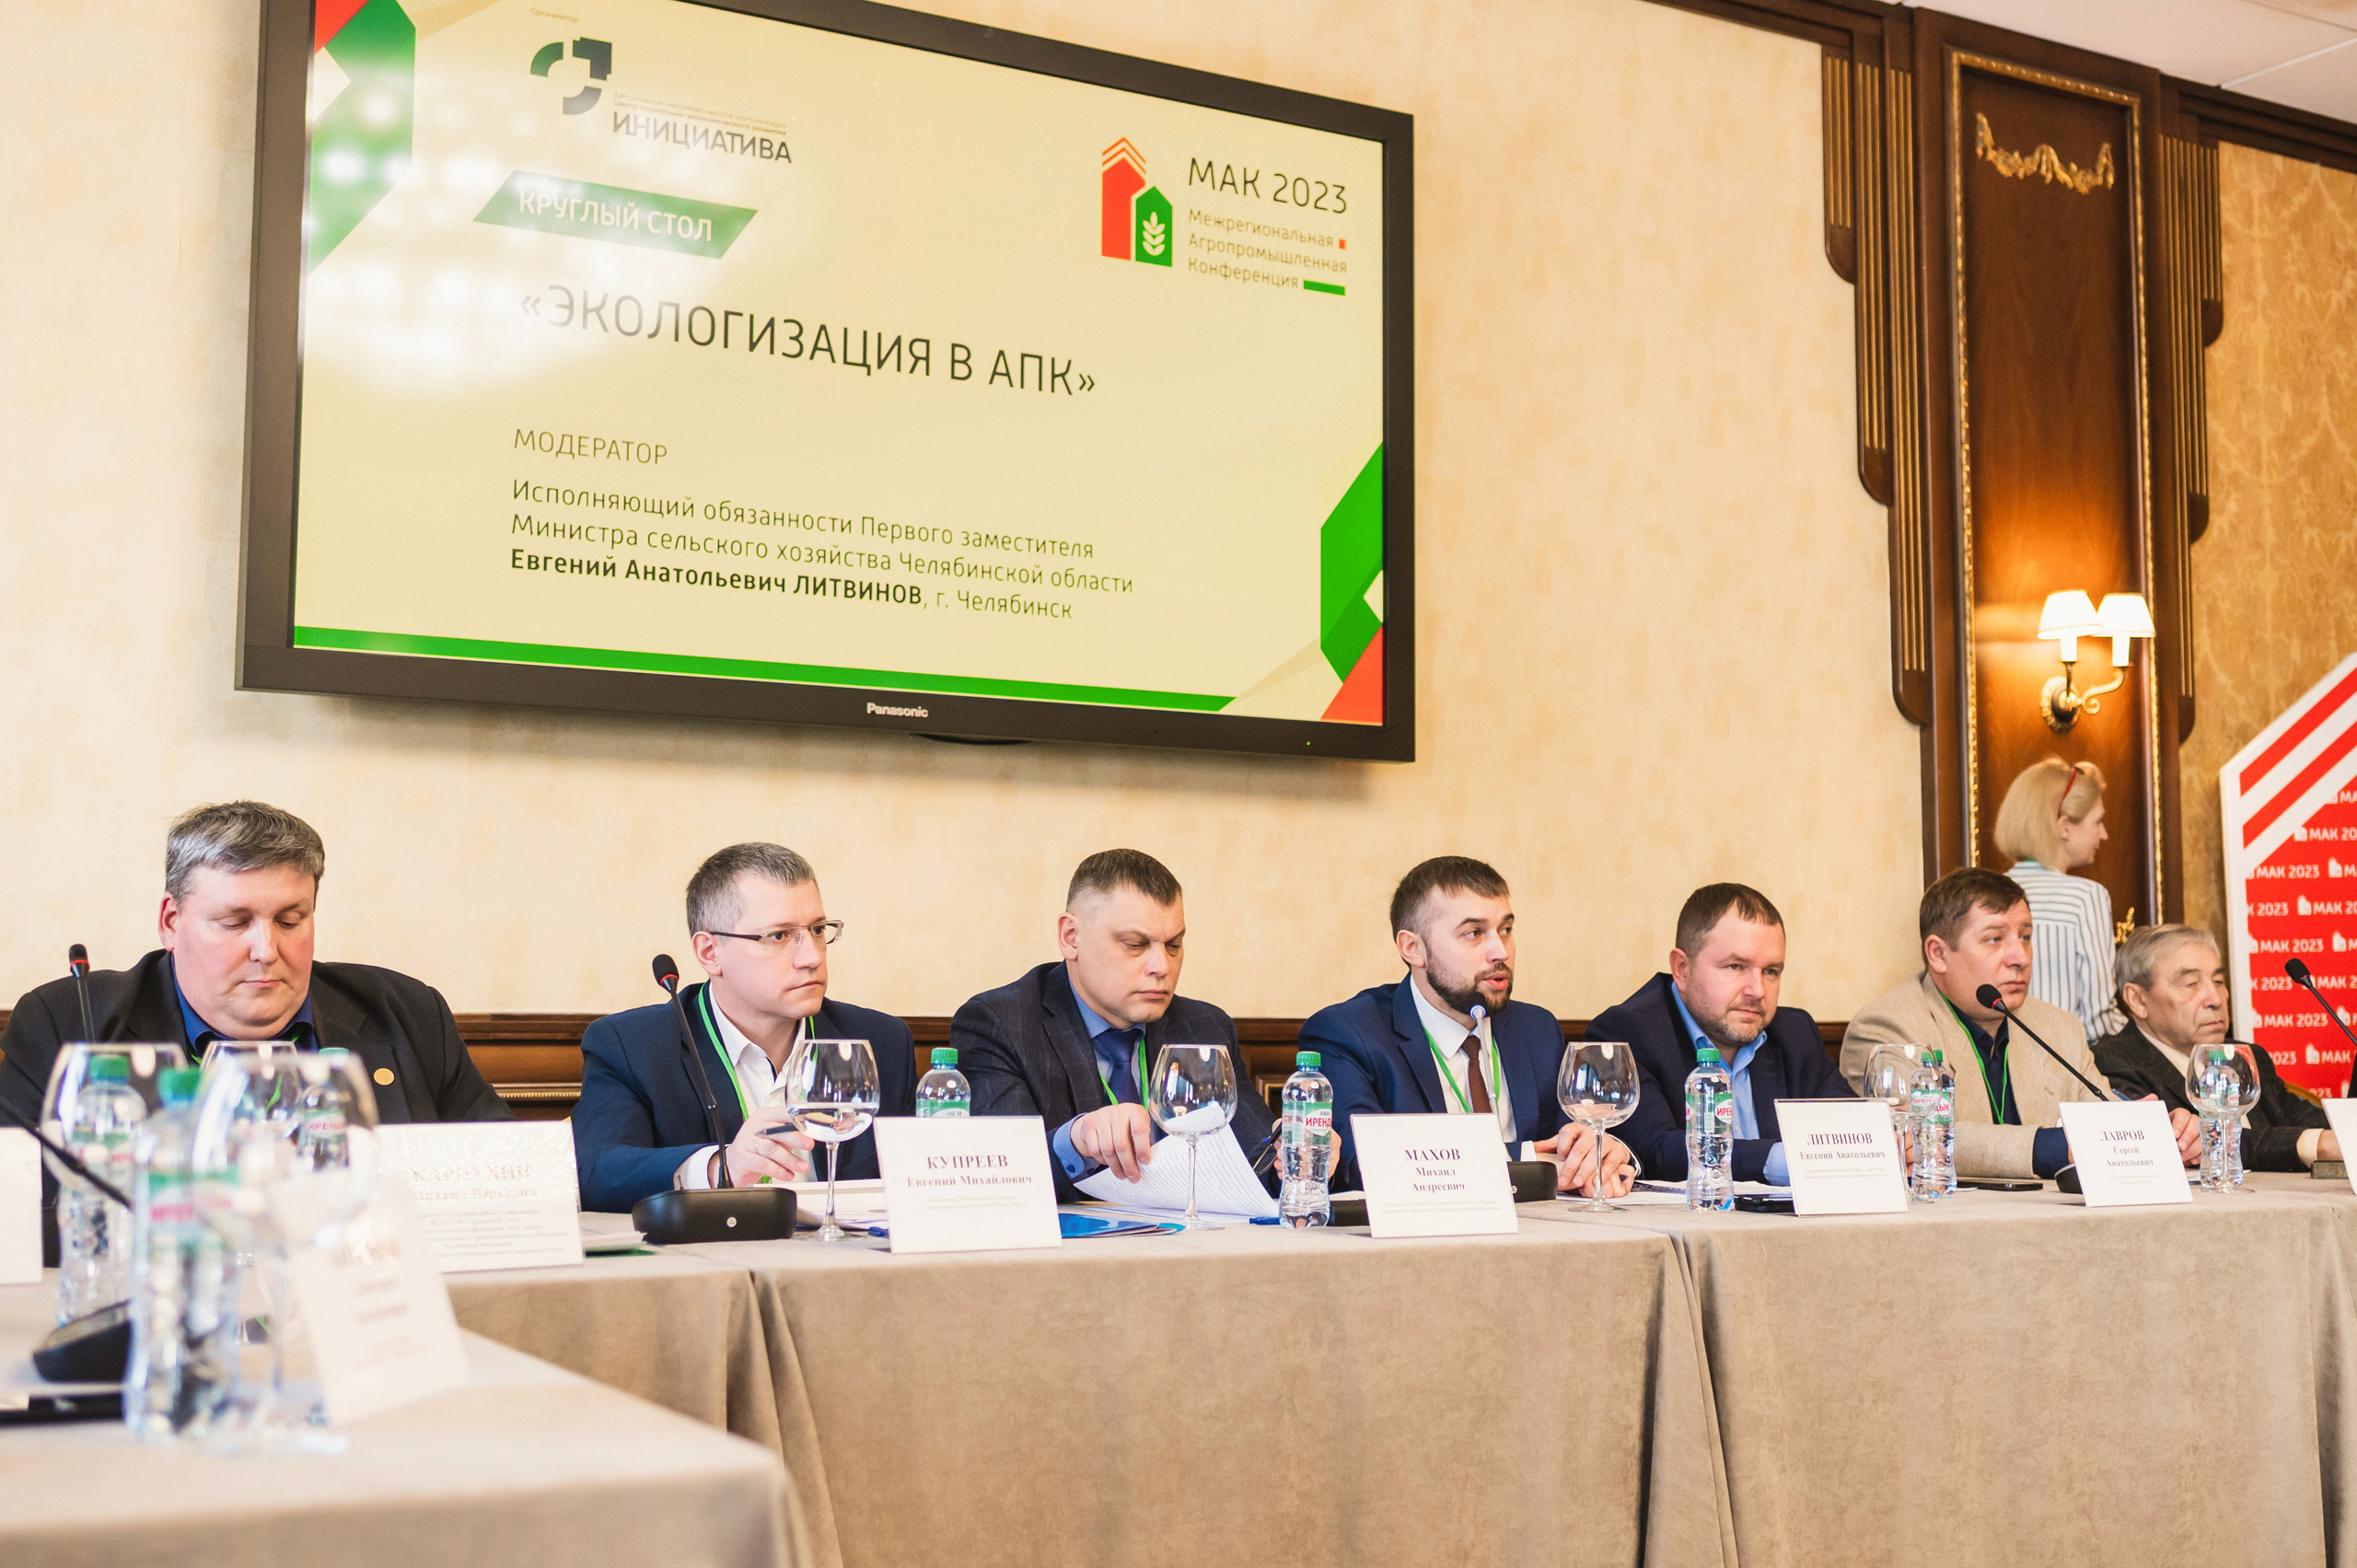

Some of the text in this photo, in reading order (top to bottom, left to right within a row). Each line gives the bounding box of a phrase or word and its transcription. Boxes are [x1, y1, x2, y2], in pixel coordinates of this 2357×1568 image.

[613, 111, 792, 164] ИНИЦИАТИВА
[1189, 157, 1347, 214] МАК 2023
[518, 190, 713, 242] КРУГЛЫЙ СТОЛ
[1189, 209, 1334, 249] Межрегиональная
[1189, 232, 1348, 273] Агропромышленная
[1189, 257, 1299, 289] Конференция
[519, 285, 1096, 396] «ЭКОЛОГИЗАЦИЯ В АПК»
[514, 428, 668, 464] МОДЕРАТОР
[513, 479, 1094, 559] Исполняющий обязанности Первого заместителя
[511, 513, 1133, 594] Министра сельского хозяйства Челябинской области
[511, 548, 1073, 619] Евгений Анатольевич ЛИТВИНОВ, г. Челябинск
[866, 703, 929, 718] Panasonic
[2309, 827, 2357, 841] МАК 20
[2257, 864, 2320, 878] МАК 2023
[2258, 902, 2289, 916] 2023
[2313, 901, 2343, 915] МАК
[2260, 938, 2324, 953] МАК 2023
[2261, 976, 2293, 991] 2023
[2317, 976, 2346, 989] МАК
[2264, 1013, 2328, 1028] МАК 2023
[2321, 1051, 2351, 1063] МАК
[1306, 1117, 1331, 1129] ИРЕНД
[1806, 1132, 1873, 1145] ЛИТВИНОВ
[2100, 1130, 2145, 1142] ЛАВРОВ
[1404, 1148, 1461, 1162] МАХОВ
[1800, 1151, 1886, 1160] Евгений Анатольевич
[2113, 1145, 2140, 1156] Сергей
[926, 1155, 1009, 1170] КУПРЕЕВ
[2107, 1159, 2154, 1167] Анатольевич
[1415, 1167, 1457, 1177] Михаил
[907, 1174, 1032, 1188] Евгений Михайлович
[1411, 1182, 1466, 1193] Андреевич
